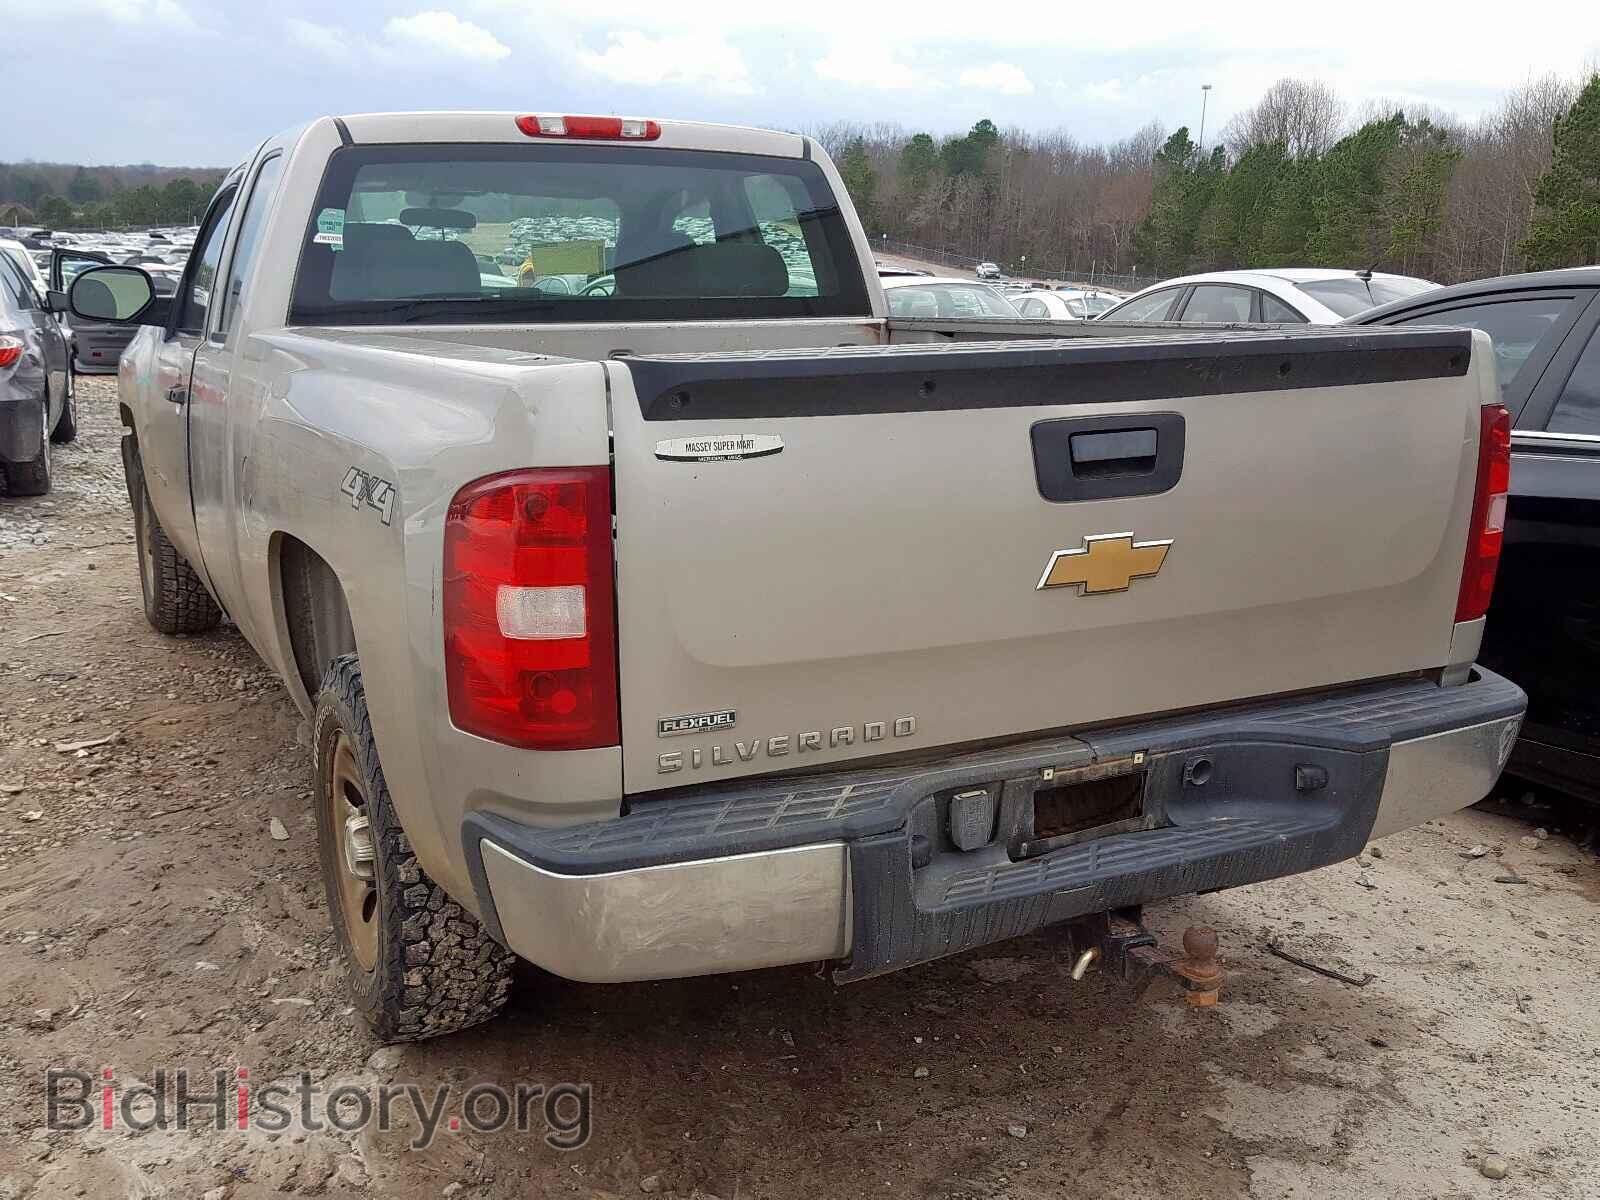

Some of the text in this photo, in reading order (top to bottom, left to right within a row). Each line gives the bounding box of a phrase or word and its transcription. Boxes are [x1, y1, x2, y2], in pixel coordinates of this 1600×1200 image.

[685, 439, 755, 453] MASSEY SUPER MART
[657, 716, 917, 774] SILVERADO
